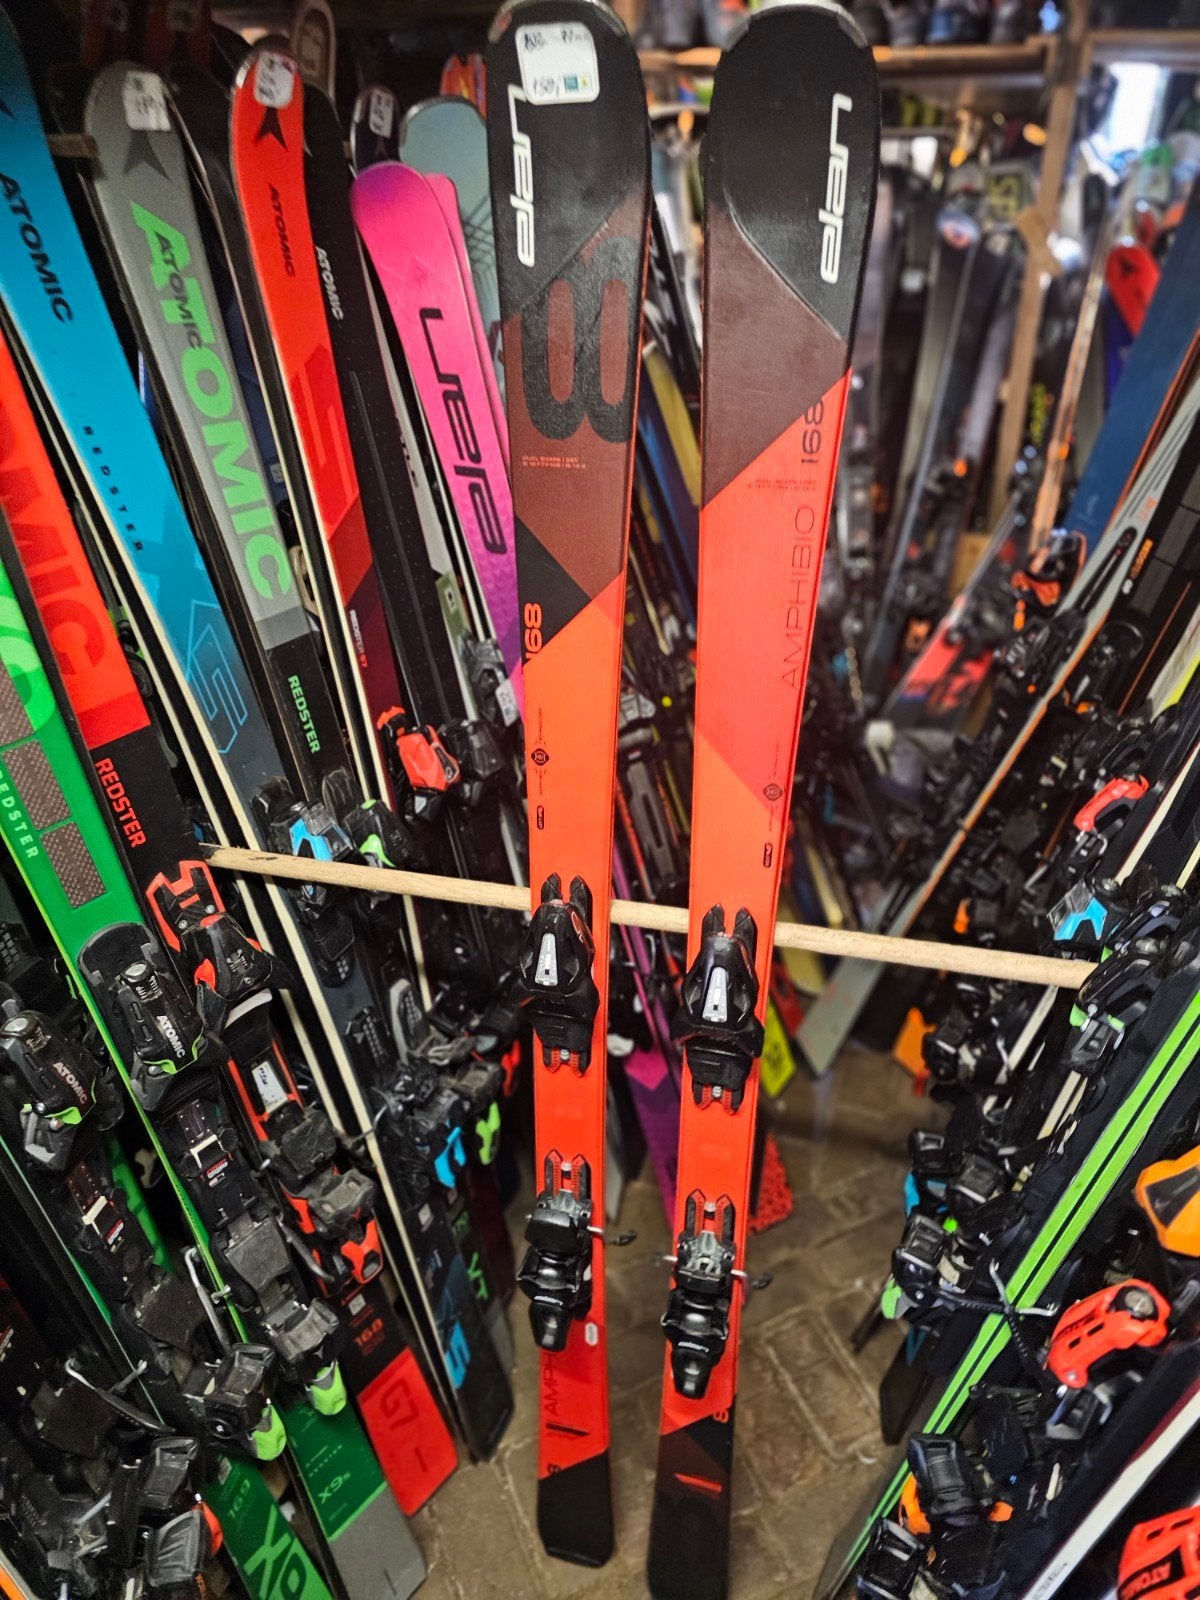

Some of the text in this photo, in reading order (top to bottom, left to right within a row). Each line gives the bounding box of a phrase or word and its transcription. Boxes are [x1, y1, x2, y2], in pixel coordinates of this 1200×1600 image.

[508, 84, 535, 267] elan
[818, 93, 852, 284] elan
[0, 173, 74, 324] ATOMIC
[269, 182, 296, 279] ATOMIC
[155, 232, 203, 350] ATOMIC
[315, 245, 344, 321] ATOMIC
[419, 307, 508, 556] elan
[782, 506, 816, 691] AMPHIBIO
[288, 675, 321, 754] REDSTER
[0, 769, 39, 858] EDSTER
[95, 757, 147, 848] REDSTER
[52, 1061, 88, 1105] ATOMIC
[157, 1015, 186, 1059] ATOMIC
